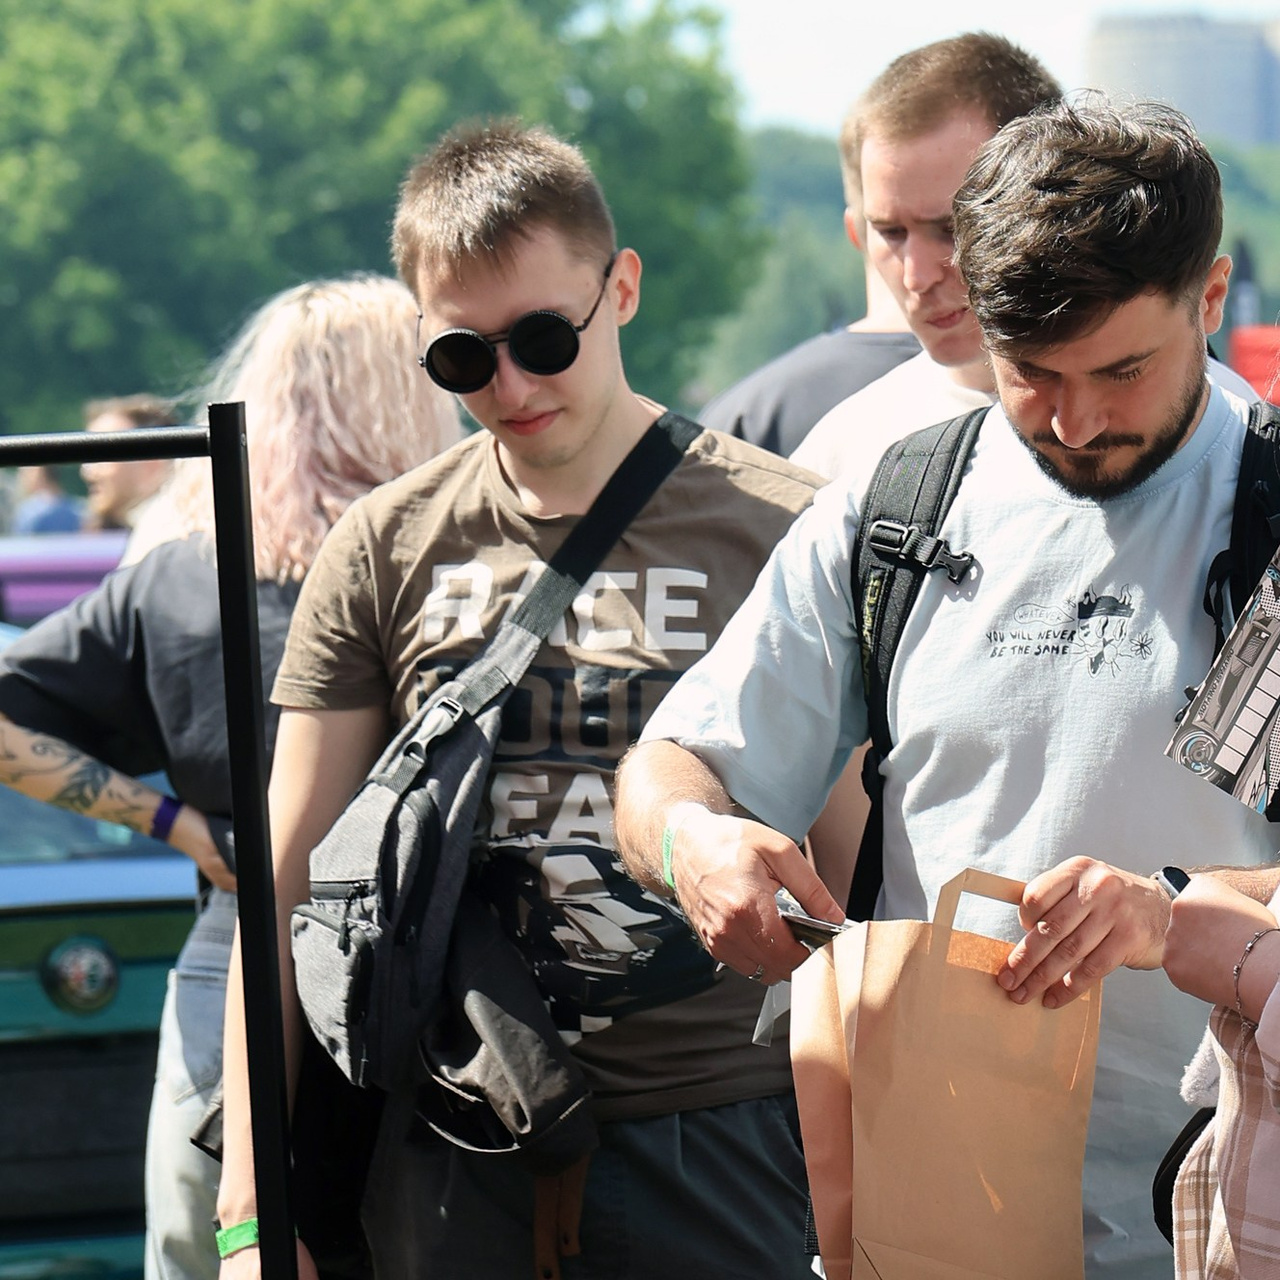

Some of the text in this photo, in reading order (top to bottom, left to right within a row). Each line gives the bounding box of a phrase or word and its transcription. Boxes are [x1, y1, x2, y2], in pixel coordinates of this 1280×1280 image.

[986, 629, 1077, 643] YOU WILL NEVER
[990, 645, 1070, 658] BE THE SAME
